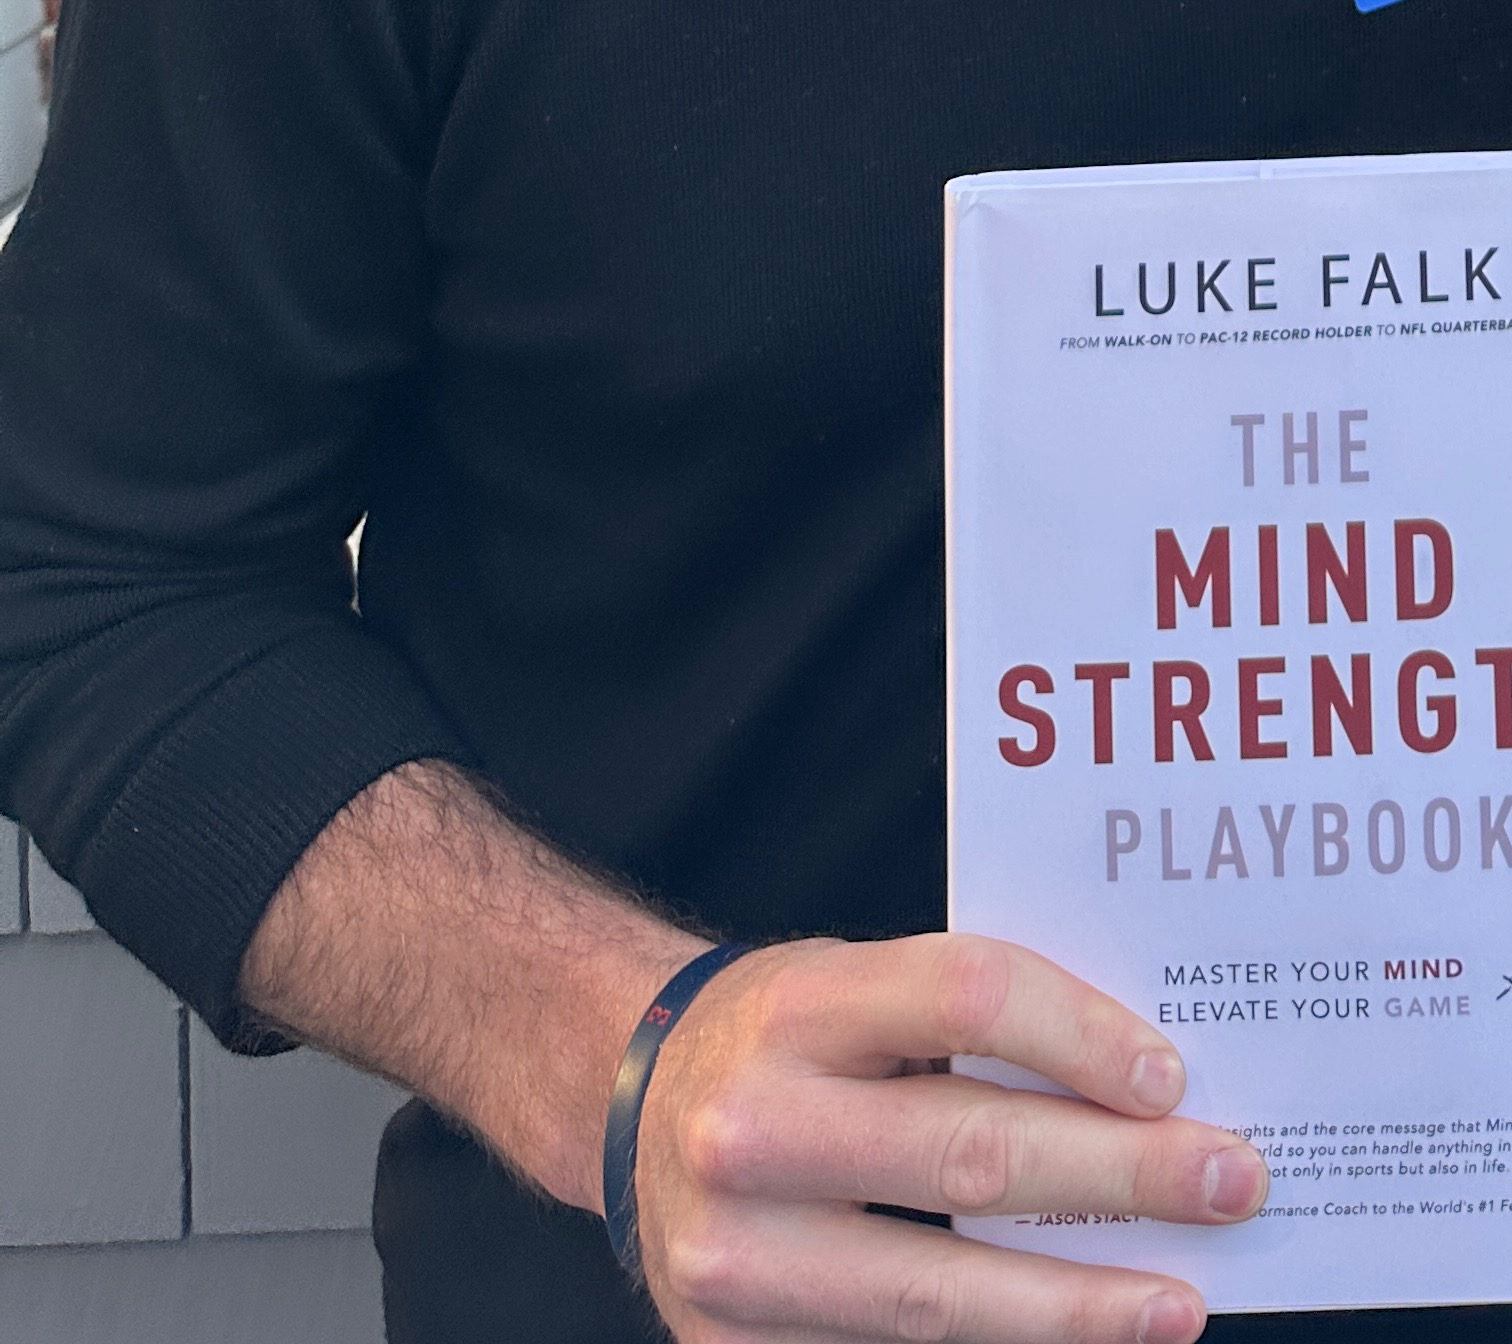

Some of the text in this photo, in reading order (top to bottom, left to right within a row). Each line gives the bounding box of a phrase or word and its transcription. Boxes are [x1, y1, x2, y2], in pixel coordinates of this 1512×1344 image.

[1094, 246, 1502, 317] LUKE FALK
[1060, 336, 1100, 350] FROM
[1105, 333, 1172, 347] WALK-ON
[1178, 332, 1196, 345] TO
[1200, 329, 1248, 344] PAC-12
[1253, 327, 1310, 342] RECORD
[1315, 324, 1372, 339] HOLDER
[1377, 323, 1396, 336] TO
[1400, 322, 1427, 335] NFL
[1230, 409, 1370, 487] THE
[1154, 518, 1455, 631] MIND
[1164, 958, 1464, 986] MASTER YOUR MIND
[1159, 995, 1471, 1023] ELEVATE YOUR GAME
[1218, 1122, 1275, 1141] sights
[1280, 1122, 1309, 1137] and
[1314, 1121, 1337, 1135] the
[1342, 1122, 1375, 1135] core
[1380, 1121, 1446, 1137] message
[1451, 1119, 1480, 1133] that
[1287, 1147, 1304, 1157] so
[1309, 1146, 1336, 1160] you
[1341, 1145, 1367, 1156] can
[1372, 1141, 1423, 1155] handle
[1428, 1140, 1493, 1157] anything
[1498, 1139, 1511, 1152] in
[1292, 1162, 1324, 1180] only
[1329, 1162, 1342, 1176] in
[1347, 1162, 1393, 1178] sports
[1399, 1160, 1424, 1175] but
[1429, 1160, 1459, 1174] also
[1464, 1159, 1477, 1173] in
[1482, 1159, 1510, 1173] life.
[1324, 1202, 1367, 1216] Coach
[1372, 1202, 1387, 1214] to
[1392, 1201, 1414, 1214] the
[1420, 1199, 1474, 1214] World's
[1479, 1199, 1494, 1213] #1
